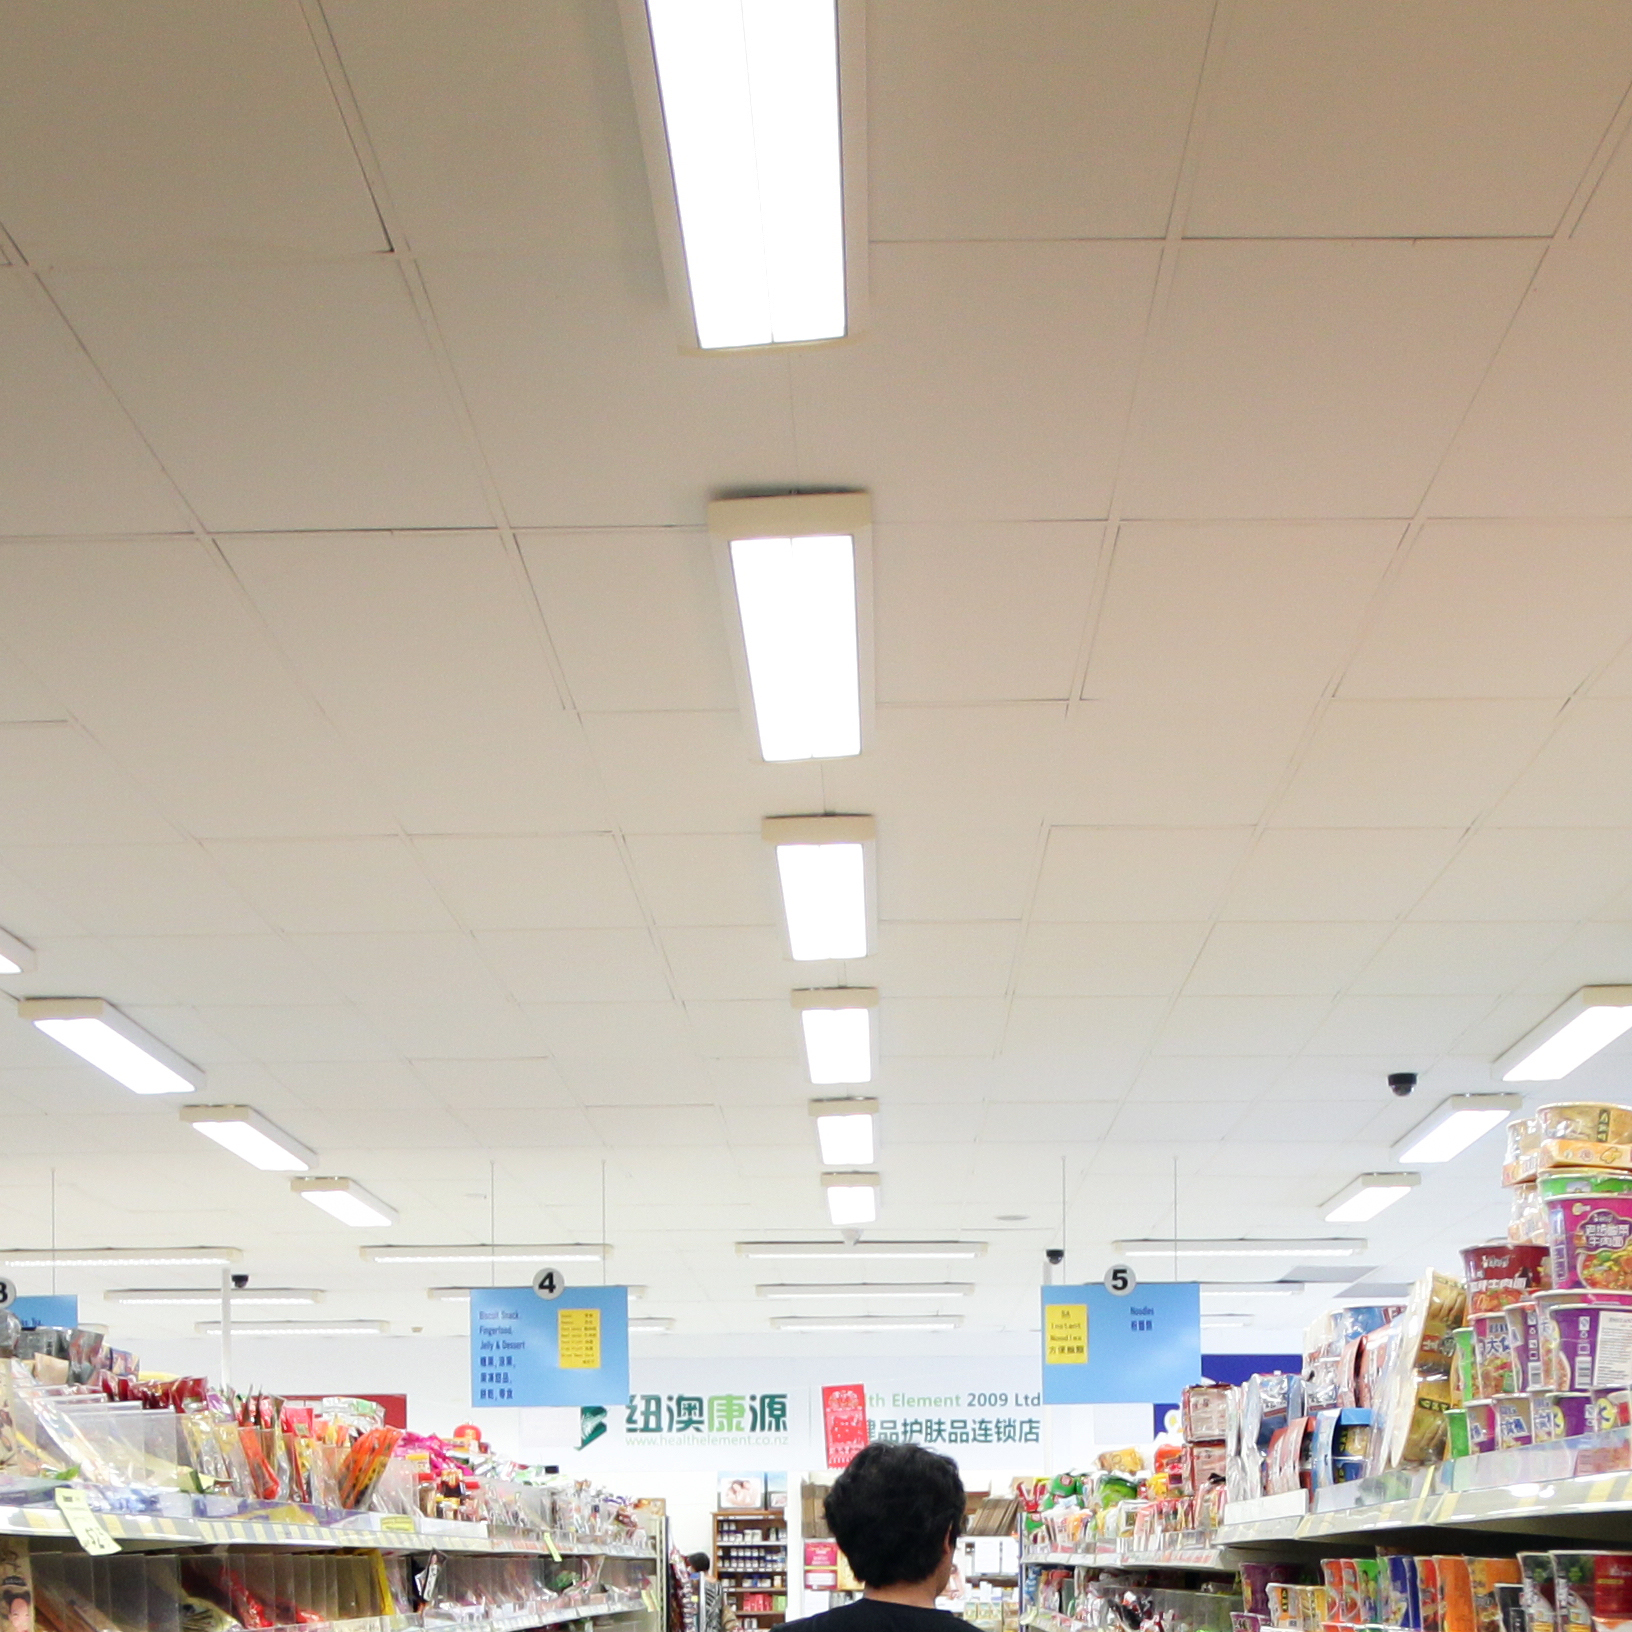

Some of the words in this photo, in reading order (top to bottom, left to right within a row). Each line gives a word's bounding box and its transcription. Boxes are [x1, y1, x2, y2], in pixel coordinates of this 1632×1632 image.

[538, 1271, 556, 1294] 4
[1111, 1269, 1128, 1291] 5
[1130, 1306, 1154, 1316] Noodles
[1051, 1322, 1082, 1330] Instant
[1050, 1334, 1082, 1342] Noodles
[480, 1340, 494, 1351] Jelly
[502, 1340, 525, 1350] Dessert
[892, 1392, 961, 1408] Element
[966, 1392, 1009, 1408] 2009
[1014, 1392, 1041, 1408] Ltd
[625, 1434, 788, 1447] www.healthelement.co.nz
